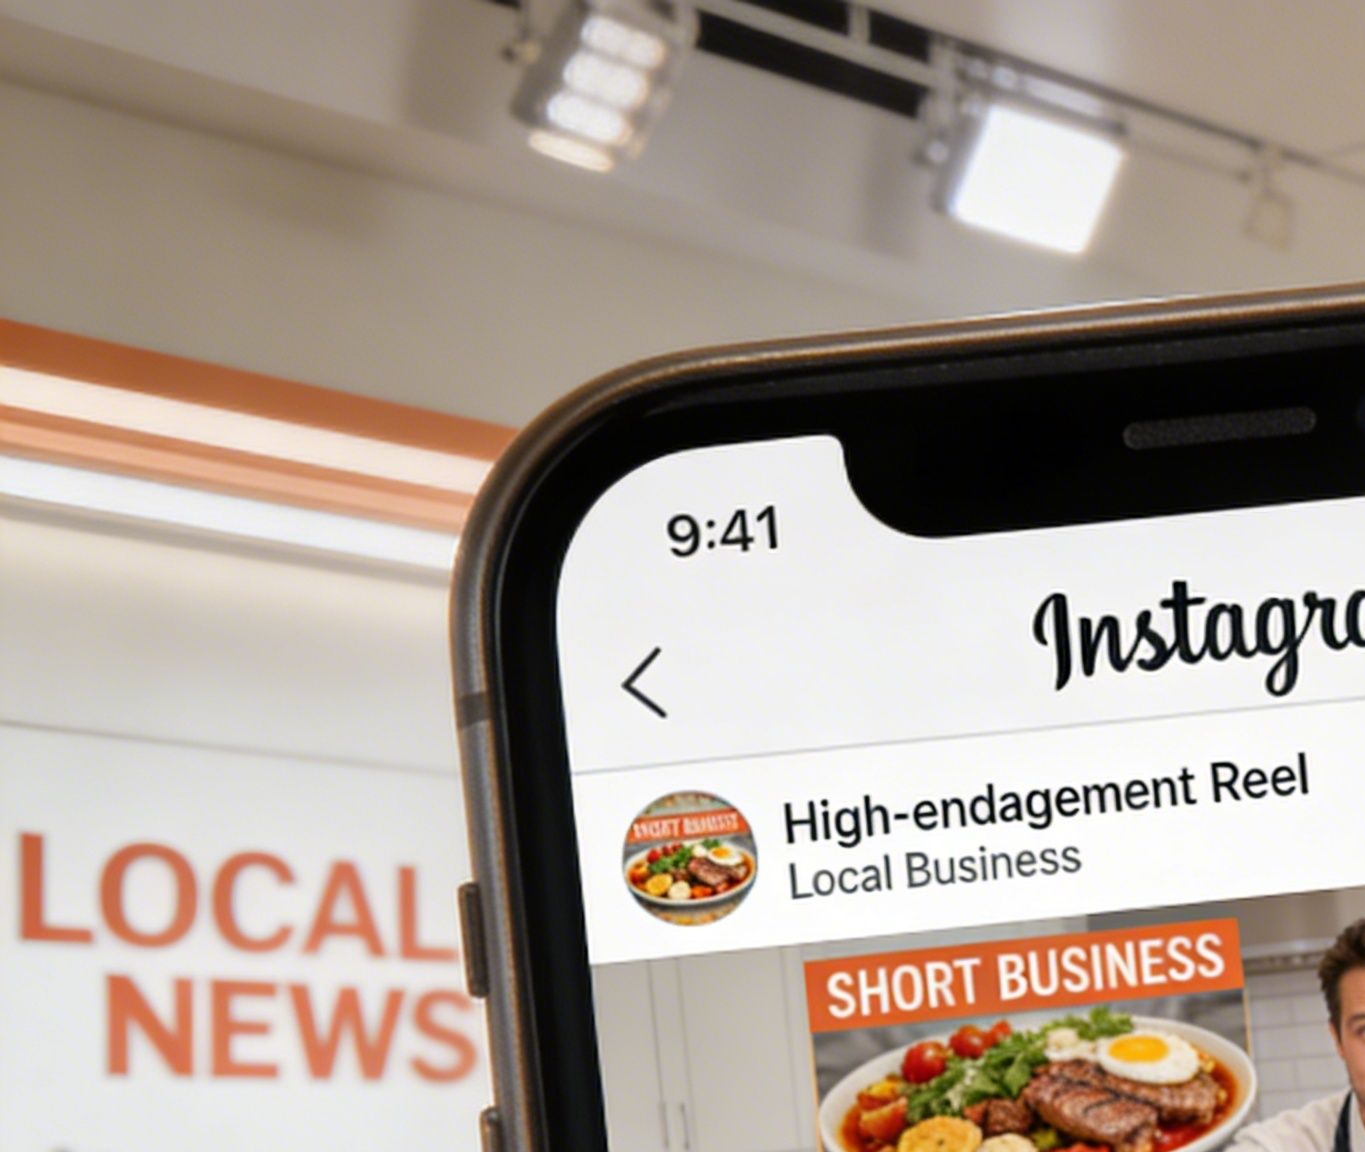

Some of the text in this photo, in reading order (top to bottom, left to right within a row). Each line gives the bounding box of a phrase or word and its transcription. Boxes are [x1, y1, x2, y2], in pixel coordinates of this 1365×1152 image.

[667, 505, 780, 557] 9:41
[783, 767, 1196, 847] High-endagement
[1210, 754, 1309, 800] Reel
[18, 832, 457, 963] LOCAL
[789, 841, 1082, 901] Local Business
[826, 933, 1225, 1019] SHORT BUSINESS
[105, 973, 478, 1084] NEWS
